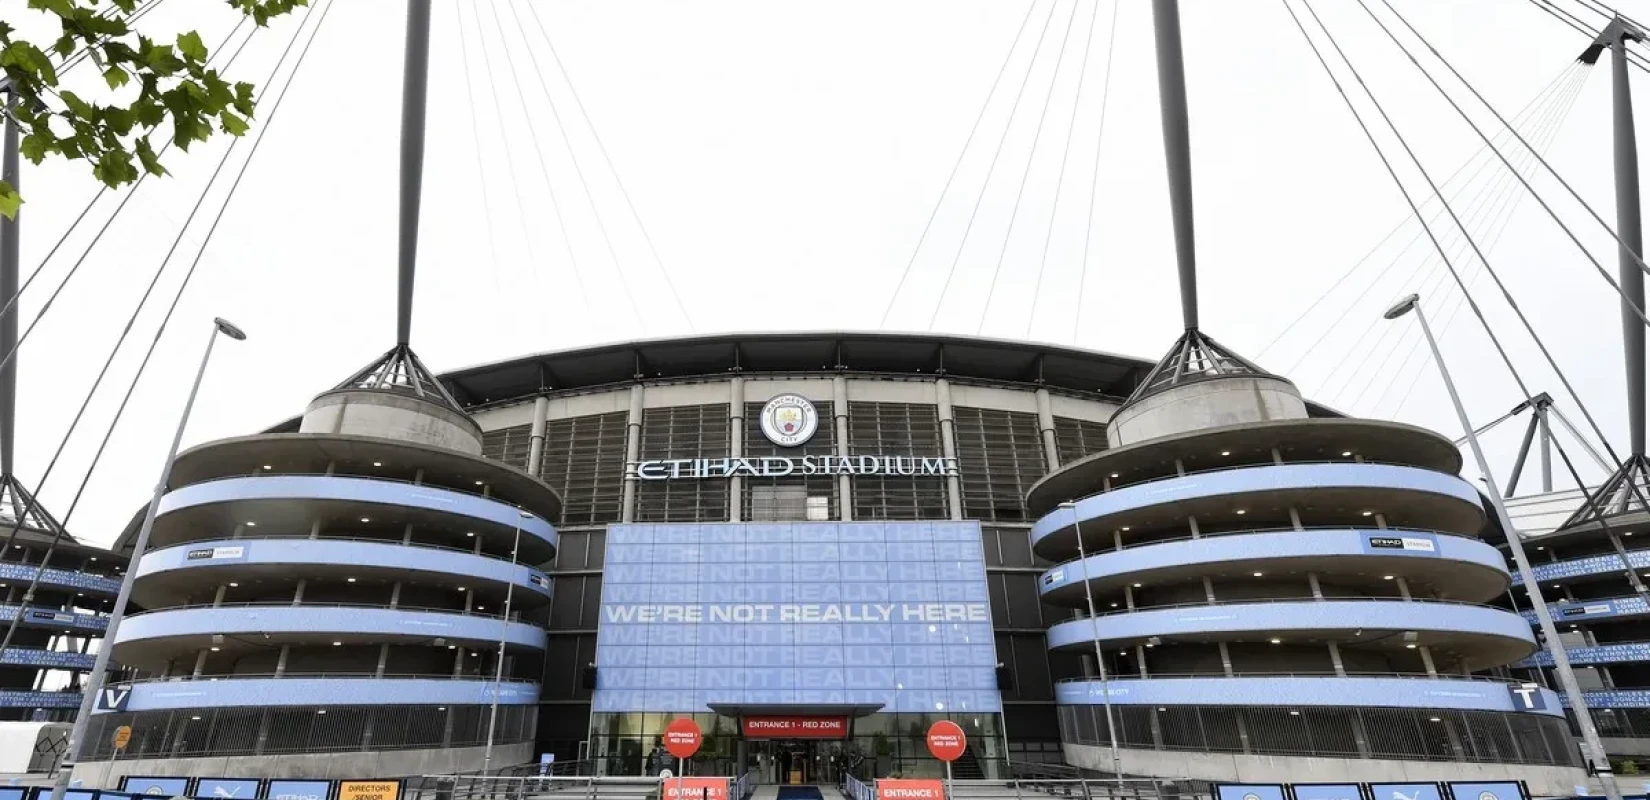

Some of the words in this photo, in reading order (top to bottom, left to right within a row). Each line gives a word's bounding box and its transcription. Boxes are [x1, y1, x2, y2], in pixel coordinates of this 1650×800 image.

[766, 396, 812, 413] MANCHESTER
[637, 457, 795, 480] ETIHAD
[802, 455, 948, 475] STADIUM
[605, 605, 702, 622] WE'RE
[709, 605, 774, 622] NOT
[780, 604, 895, 621] REALLY
[902, 604, 987, 621] HERE
[106, 690, 128, 708] V
[1513, 689, 1536, 709] T
[348, 784, 391, 792] DIRECTORS
[718, 788, 722, 796] 1
[884, 788, 932, 797] ENTRANCE
[934, 789, 939, 797] 1
